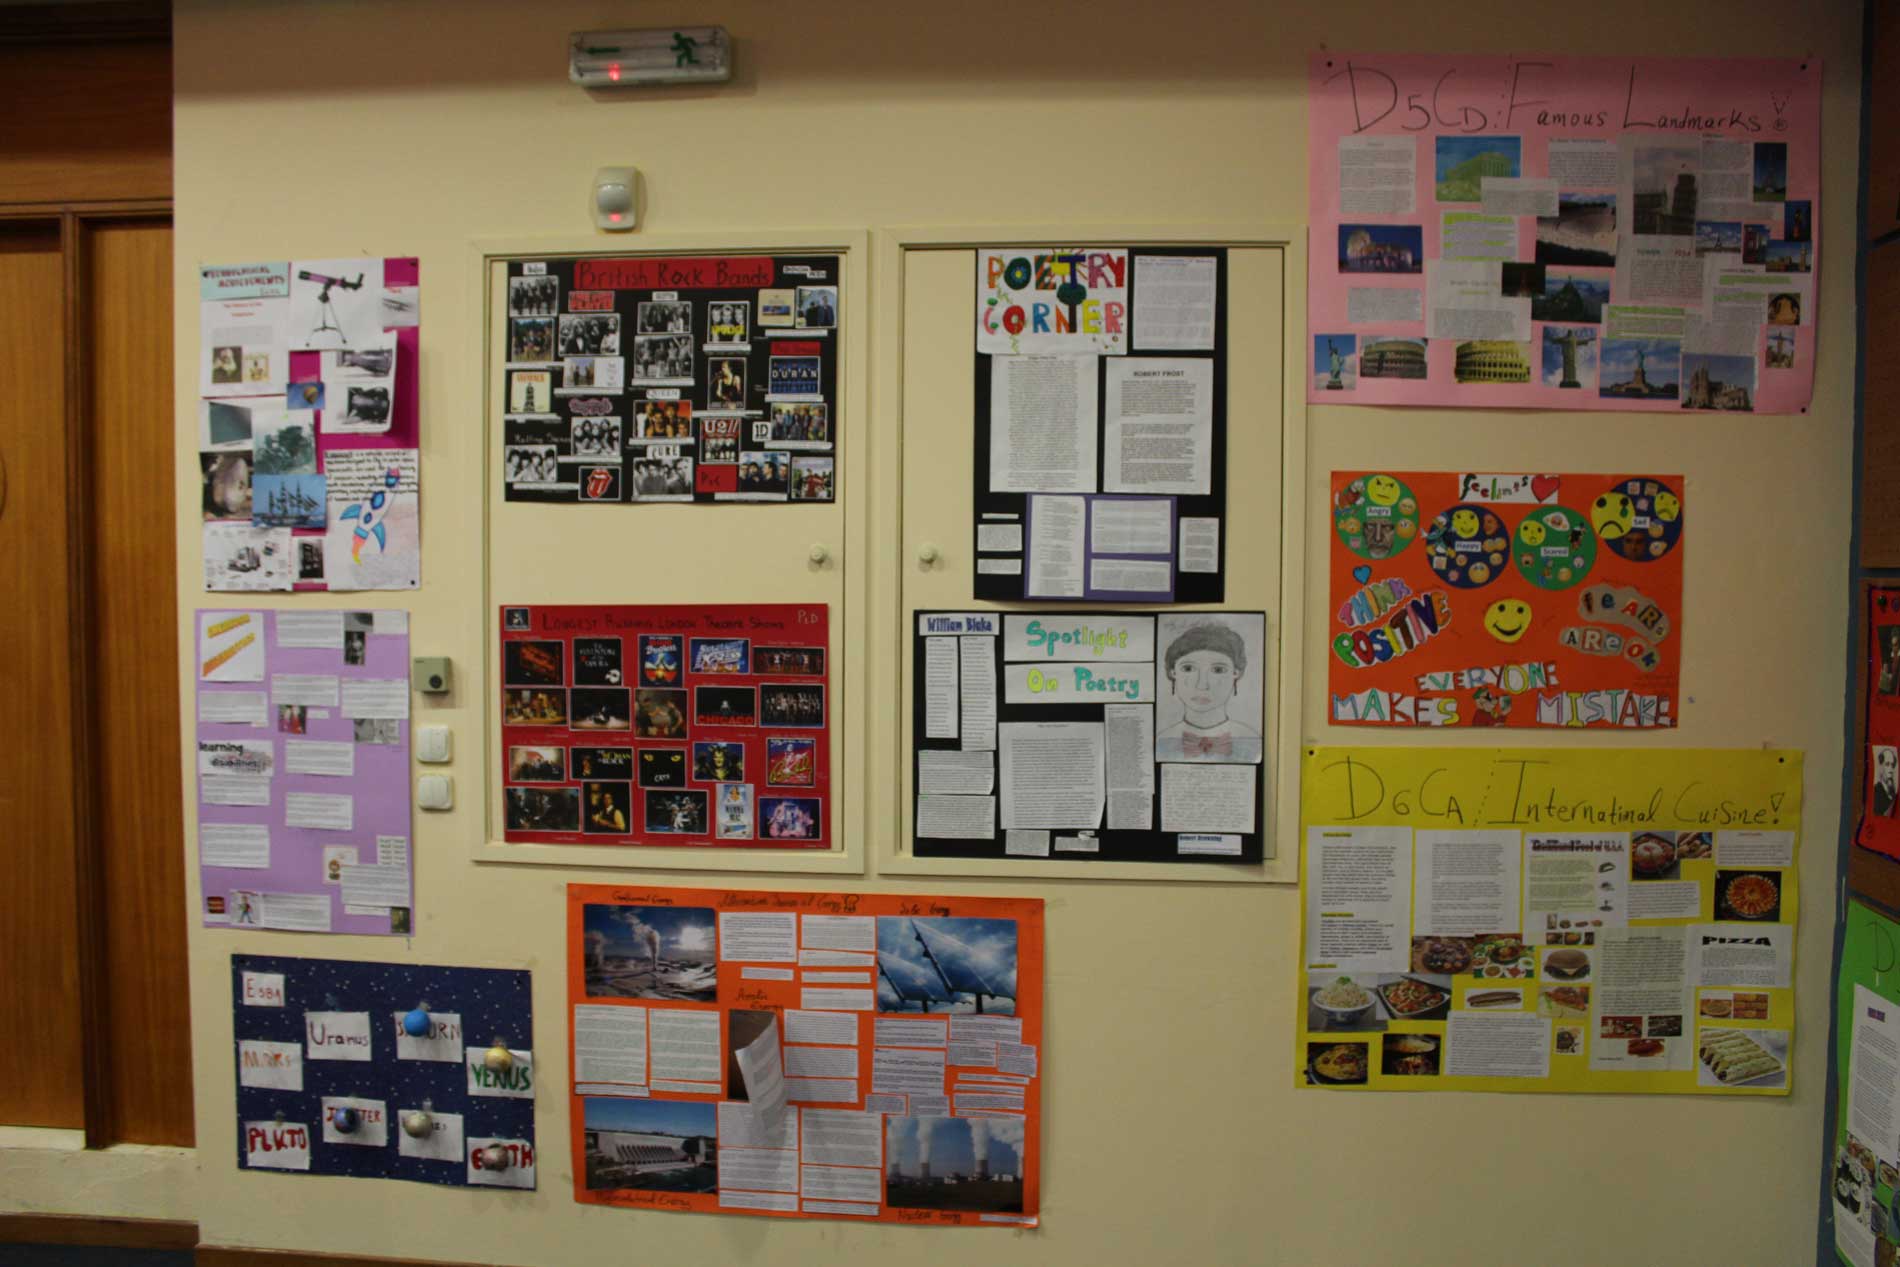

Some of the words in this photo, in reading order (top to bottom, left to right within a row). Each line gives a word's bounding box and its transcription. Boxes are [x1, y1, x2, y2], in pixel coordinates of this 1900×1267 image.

[1506, 62, 1608, 129] Famous
[578, 260, 648, 290] British
[657, 259, 704, 286] Rock
[715, 258, 770, 287] Bands
[987, 253, 1126, 290] POETRY
[983, 298, 1125, 335] CORNER
[1162, 370, 1185, 378] FROST
[1338, 578, 1412, 627] THINK
[927, 617, 963, 633] William
[966, 617, 993, 632] Blake
[1026, 620, 1129, 656] Spotlight
[1333, 590, 1453, 668] POSITIVE
[1026, 668, 1059, 694] On
[1073, 666, 1140, 699] Poetry
[1414, 664, 1560, 695] EVERYONE
[697, 715, 754, 725] CHICAGO
[1333, 688, 1460, 726] MAKES
[198, 742, 244, 755] learning
[1701, 935, 1772, 947] PIZZA
[309, 1021, 370, 1047] Uranus
[397, 1021, 460, 1041] SURN
[471, 1144, 533, 1170] ETH
